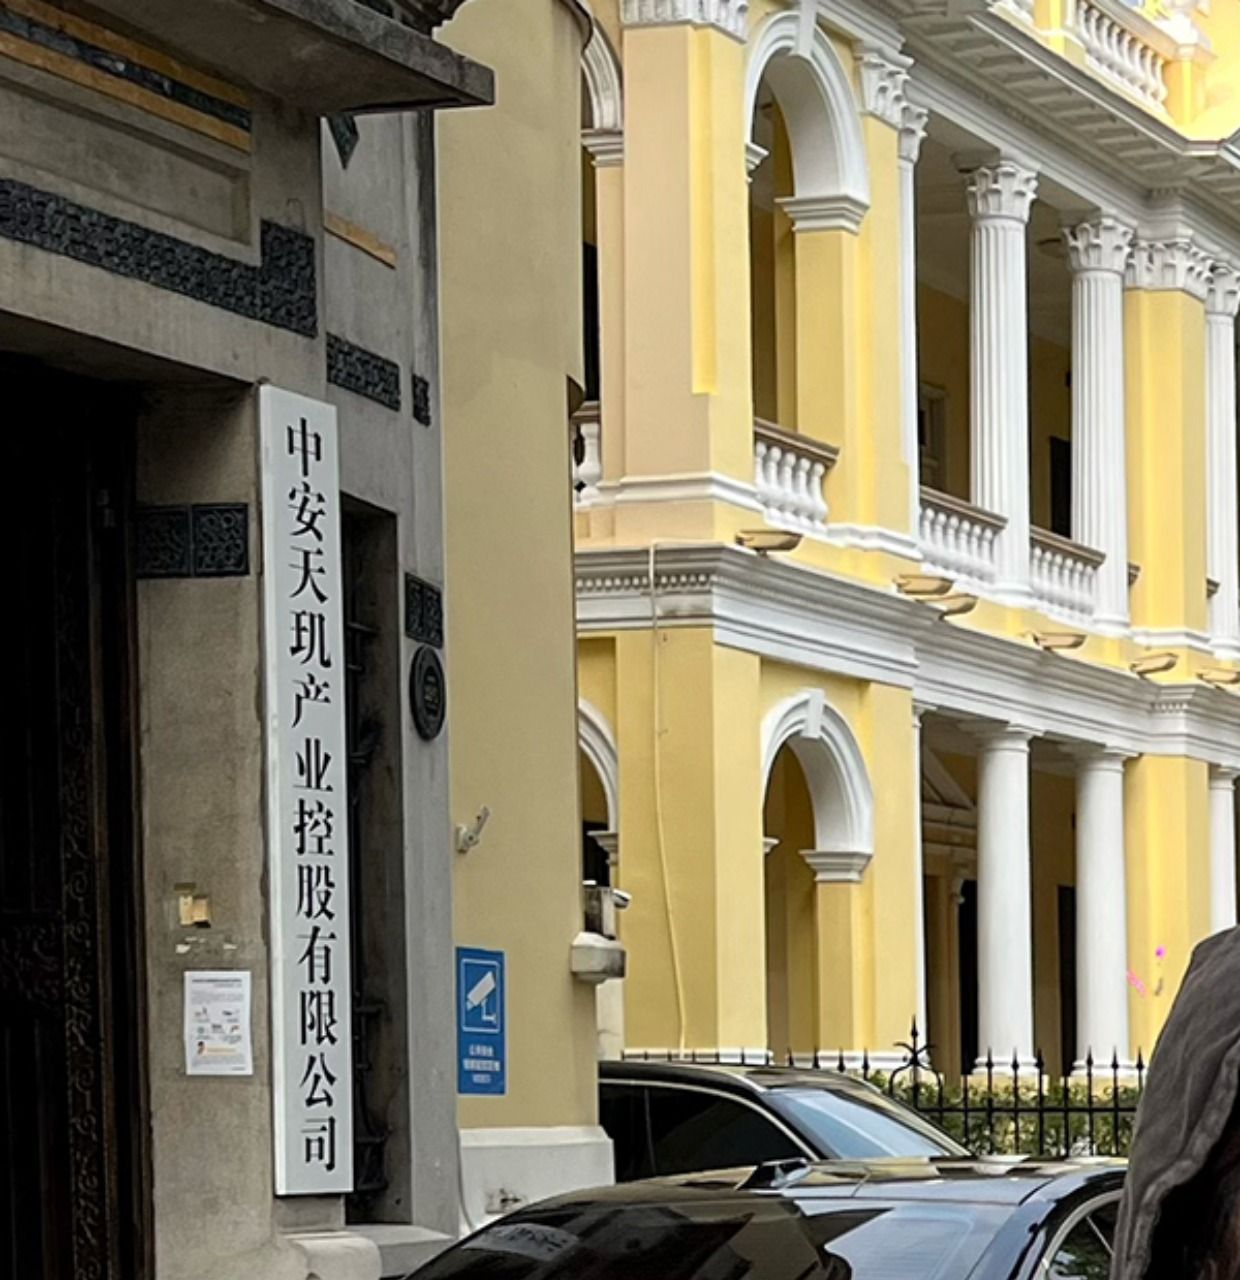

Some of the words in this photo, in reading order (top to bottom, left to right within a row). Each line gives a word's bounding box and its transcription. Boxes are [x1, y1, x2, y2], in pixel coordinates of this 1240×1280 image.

[286, 416, 337, 1172] 中安天玑产业控股有限公司
